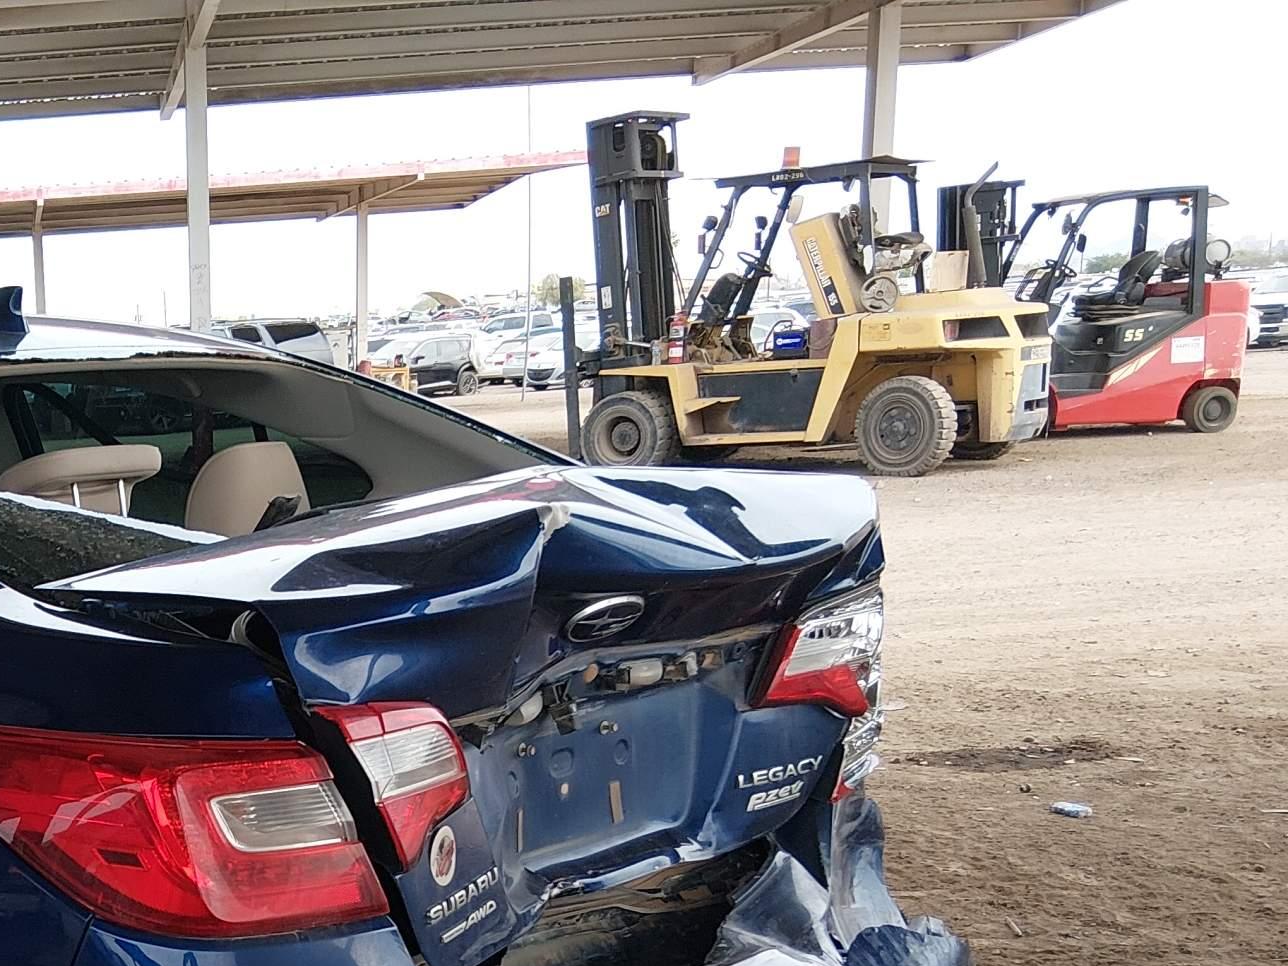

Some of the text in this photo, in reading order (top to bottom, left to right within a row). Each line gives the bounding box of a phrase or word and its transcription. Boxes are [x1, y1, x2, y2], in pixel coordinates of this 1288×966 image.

[594, 202, 611, 218] CAT
[737, 754, 824, 789] LEGACY
[428, 866, 499, 924] SUBARU
[466, 899, 497, 929] AWD
